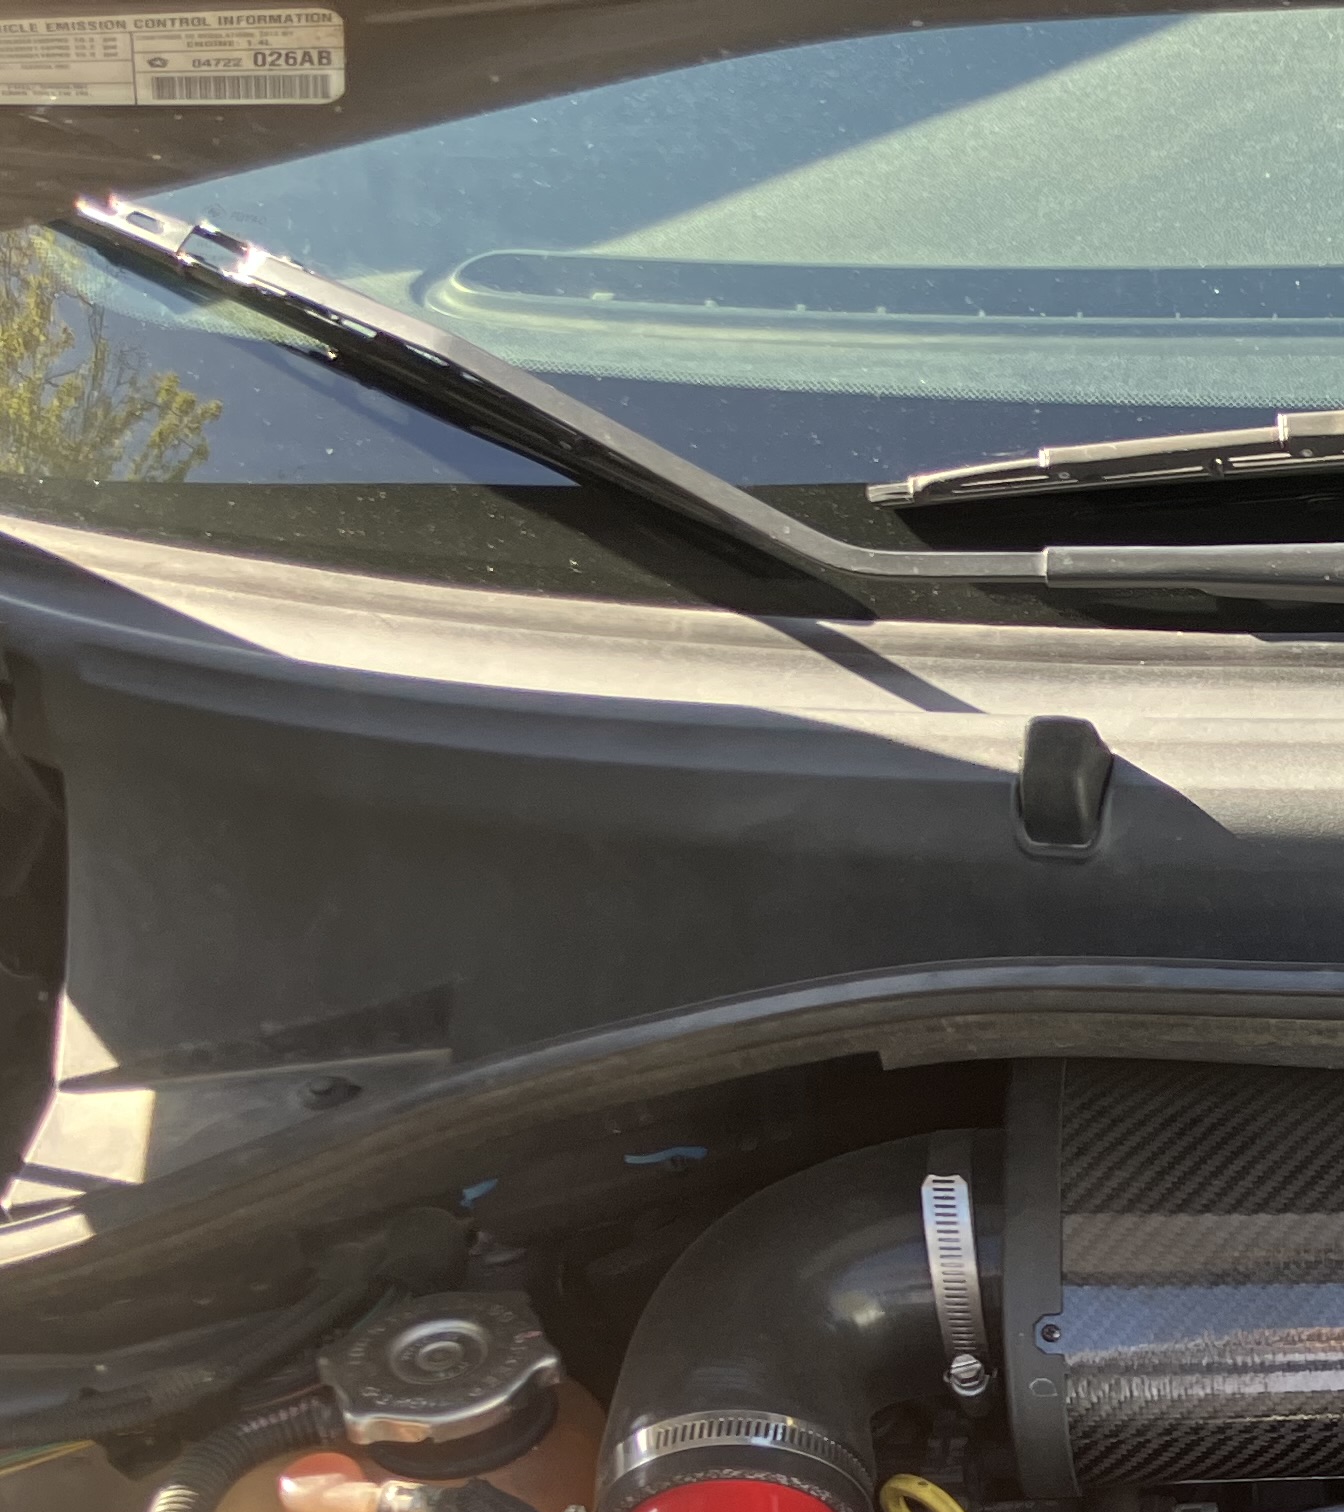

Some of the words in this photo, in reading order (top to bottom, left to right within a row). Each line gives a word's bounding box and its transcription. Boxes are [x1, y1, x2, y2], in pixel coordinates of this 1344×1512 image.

[46, 20, 126, 31] EMISSION
[134, 17, 210, 29] CONTROL
[218, 12, 333, 26] INFORMATION
[253, 50, 332, 67] 026AB
